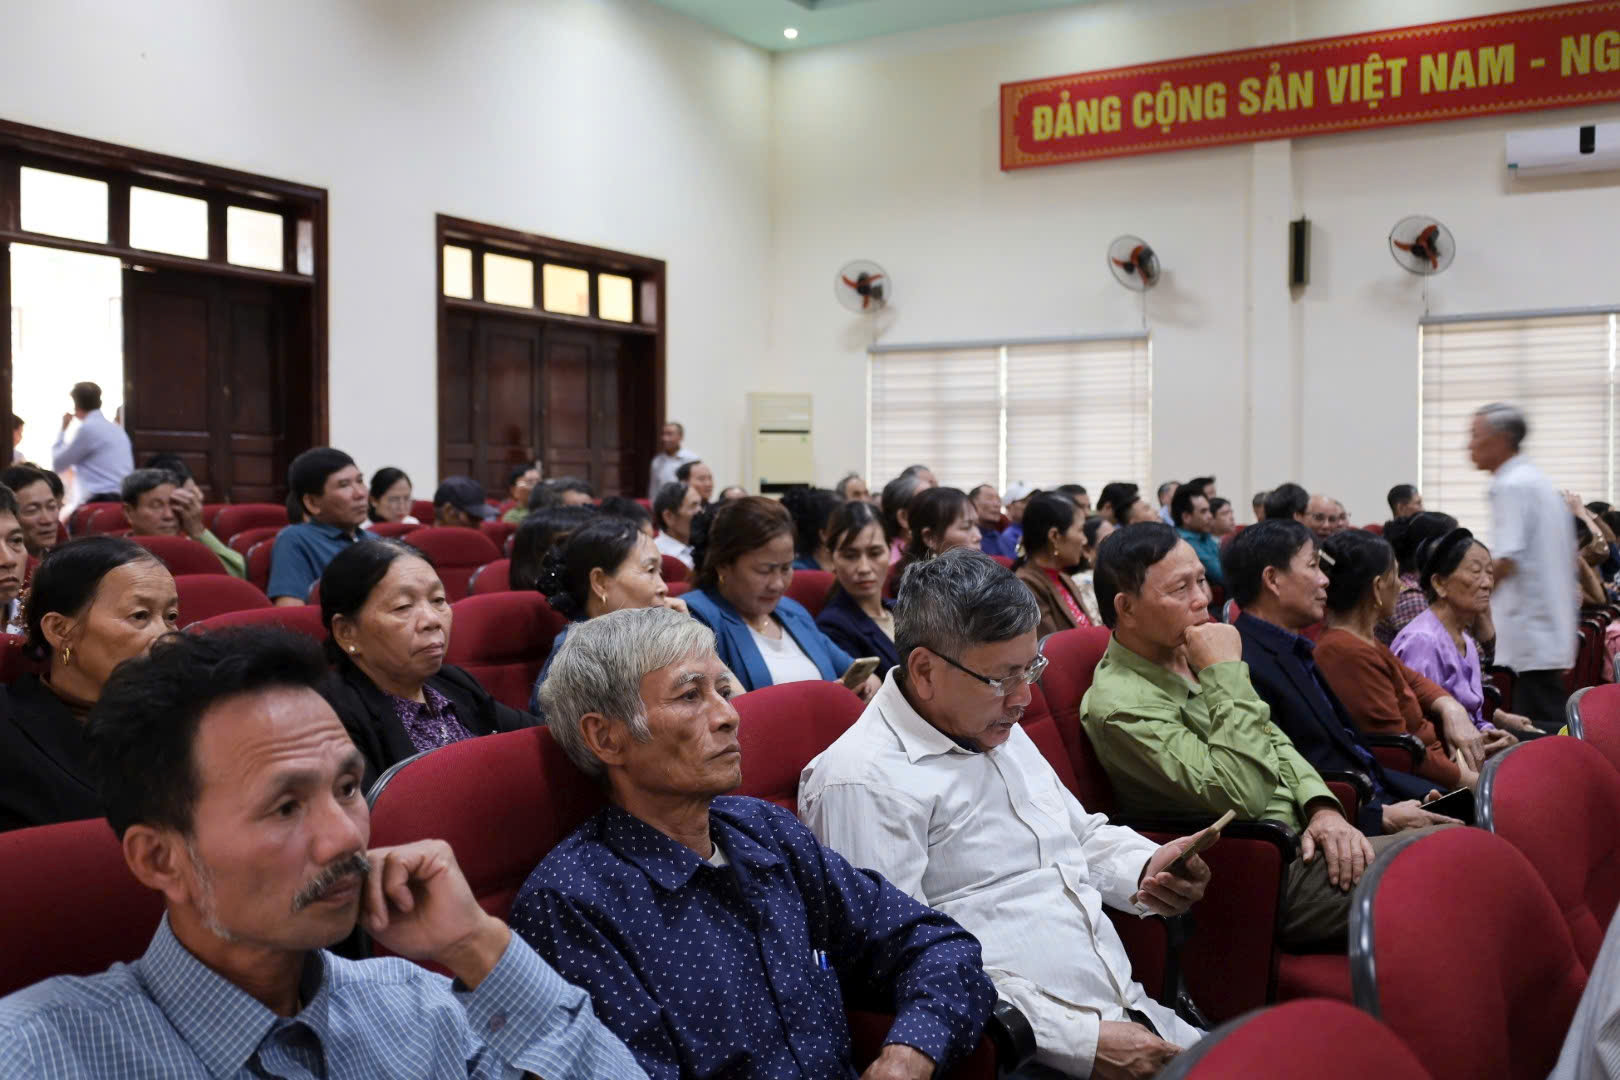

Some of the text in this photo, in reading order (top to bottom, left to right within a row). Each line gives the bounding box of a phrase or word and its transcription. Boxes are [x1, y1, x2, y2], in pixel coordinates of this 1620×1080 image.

[1033, 91, 1121, 141] ĐẢNG
[1132, 82, 1226, 133] CỘNG
[1238, 63, 1313, 115] SẢN
[1326, 53, 1408, 109] VIỆT
[1420, 44, 1515, 94] NAM
[1530, 58, 1546, 68] -
